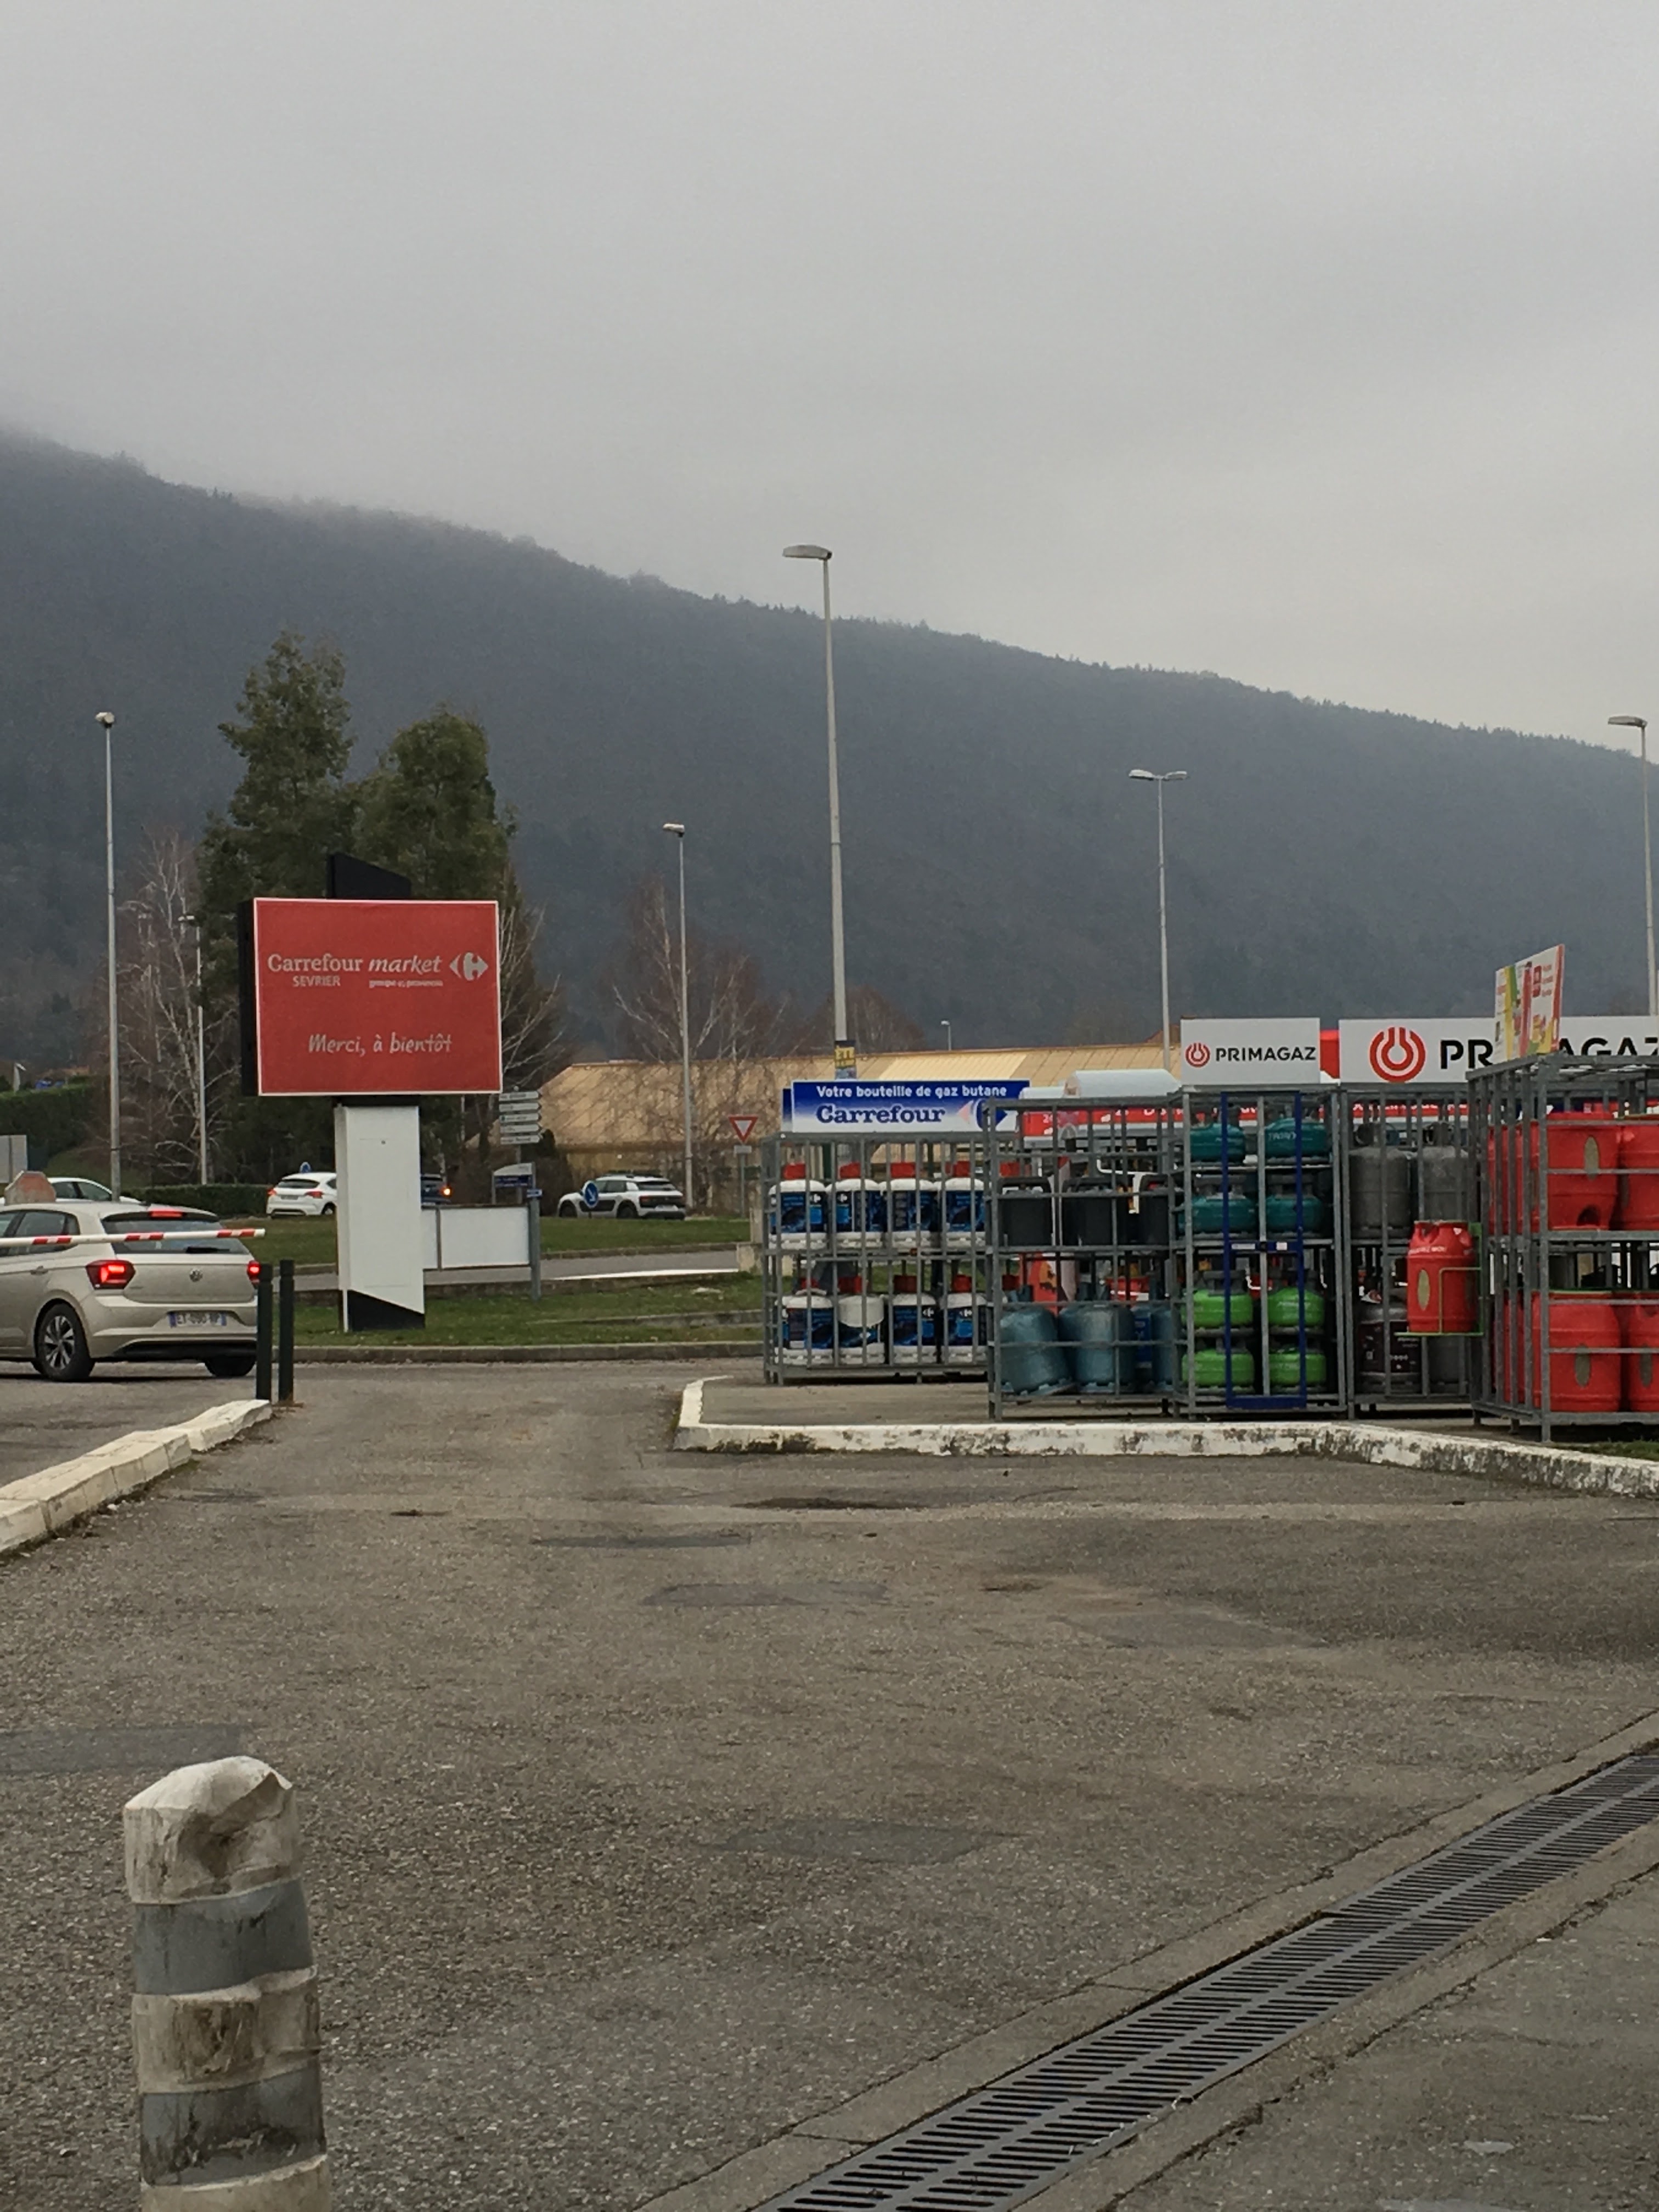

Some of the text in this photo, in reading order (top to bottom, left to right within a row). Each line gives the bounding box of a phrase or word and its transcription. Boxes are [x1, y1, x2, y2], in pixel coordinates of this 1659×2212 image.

[267, 953, 442, 975] Carrefour market
[292, 975, 341, 987] SEVRIER
[308, 1031, 453, 1057] Merci, à bientôt
[1216, 1046, 1316, 1062] PRIMAGAZ
[1440, 1037, 1658, 1069] PRAGA
[816, 1085, 1007, 1099] Votre bouteille de gaz butane
[816, 1104, 945, 1124] Carrefour
